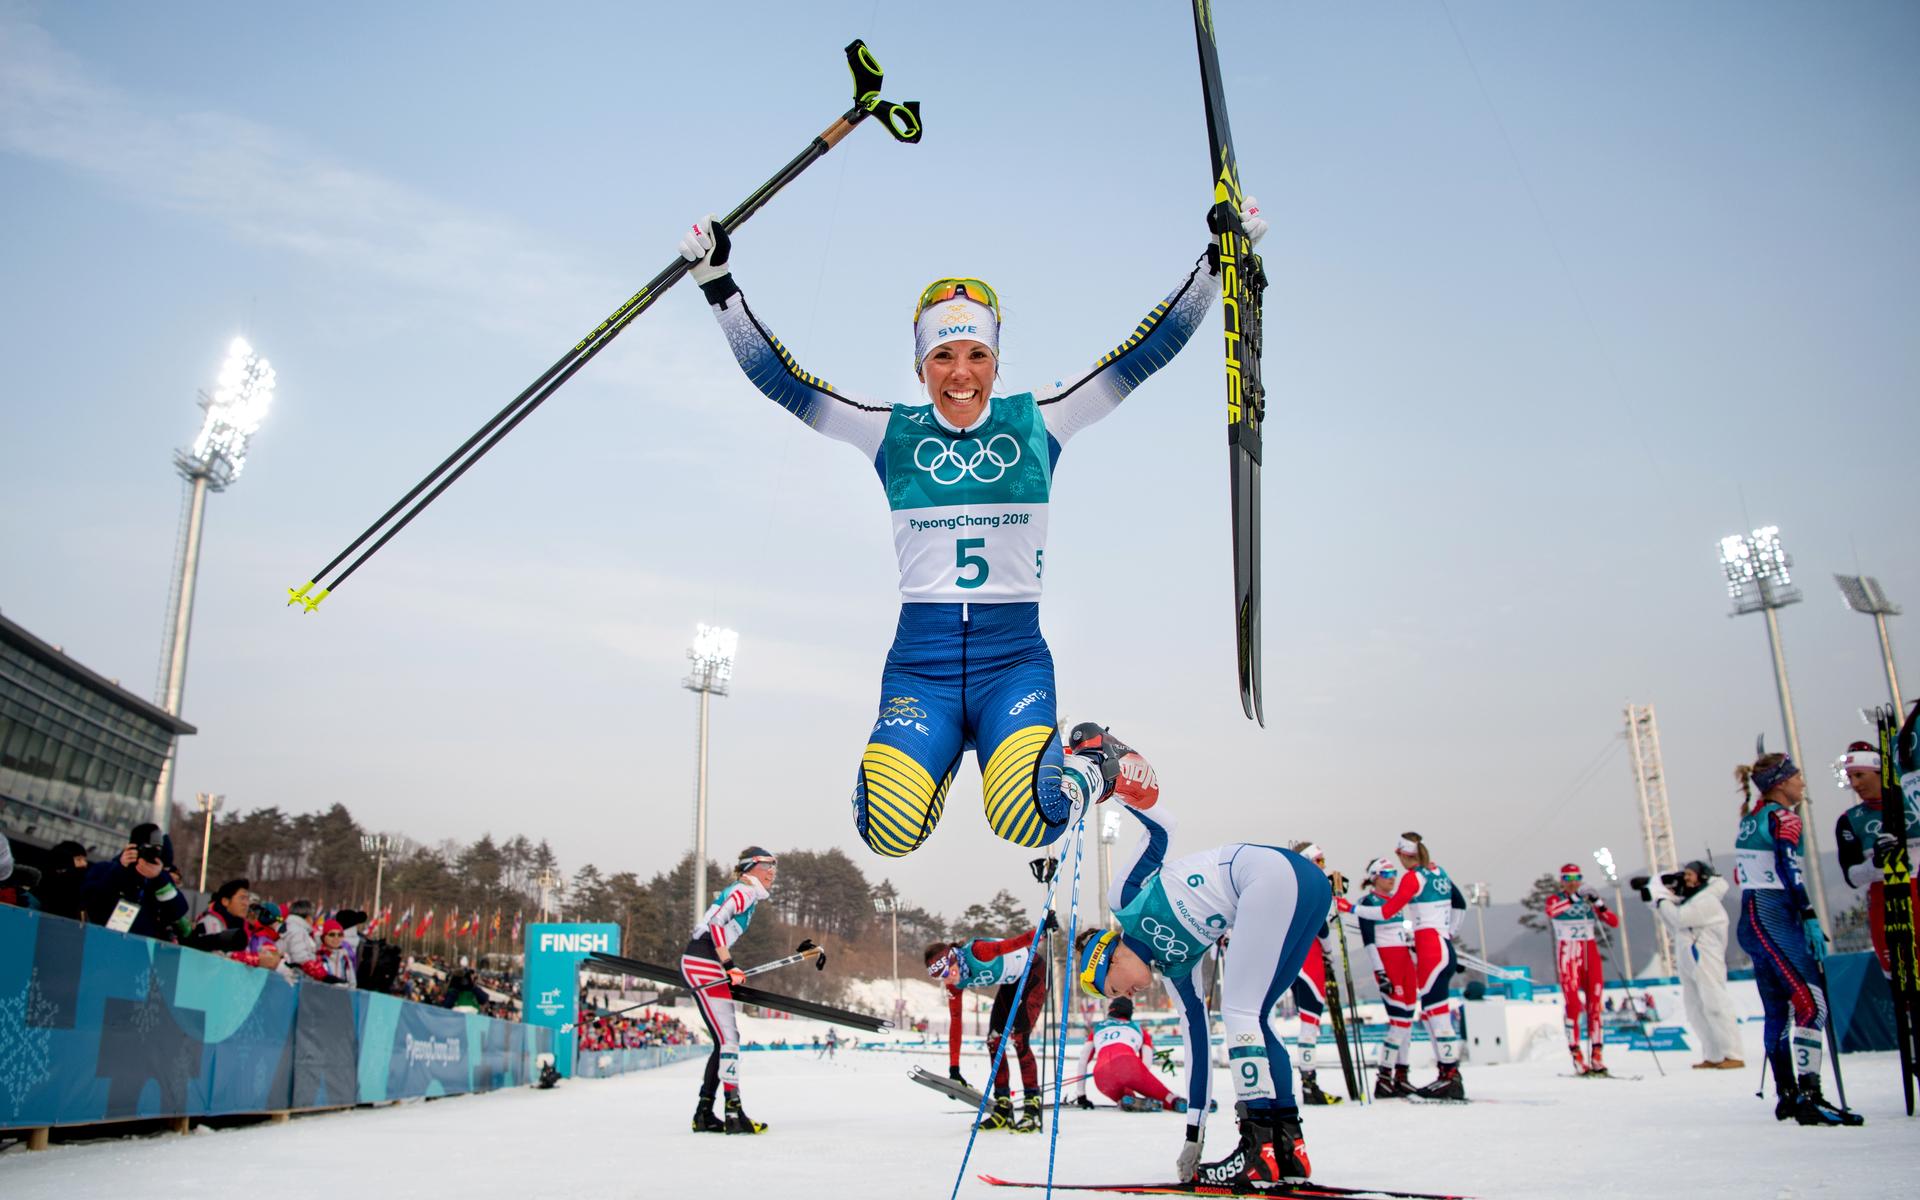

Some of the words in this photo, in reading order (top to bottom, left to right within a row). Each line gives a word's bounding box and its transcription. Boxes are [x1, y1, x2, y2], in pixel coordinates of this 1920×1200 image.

[938, 325, 977, 338] SWE
[909, 514, 1000, 531] PyeongChang
[1002, 513, 1029, 526] 2018
[955, 538, 990, 589] 5
[1036, 549, 1044, 578] 5
[1009, 691, 1041, 716] CRAFT
[872, 718, 930, 736] SWE
[1764, 870, 1775, 882] 3
[540, 934, 608, 952] FINISH
[1302, 1050, 1312, 1062] 6
[1443, 1044, 1453, 1056] 2
[1797, 1048, 1810, 1066] 3
[726, 1062, 736, 1076] 4
[1240, 1061, 1259, 1088] 9
[1206, 1152, 1246, 1182] ROSSI
